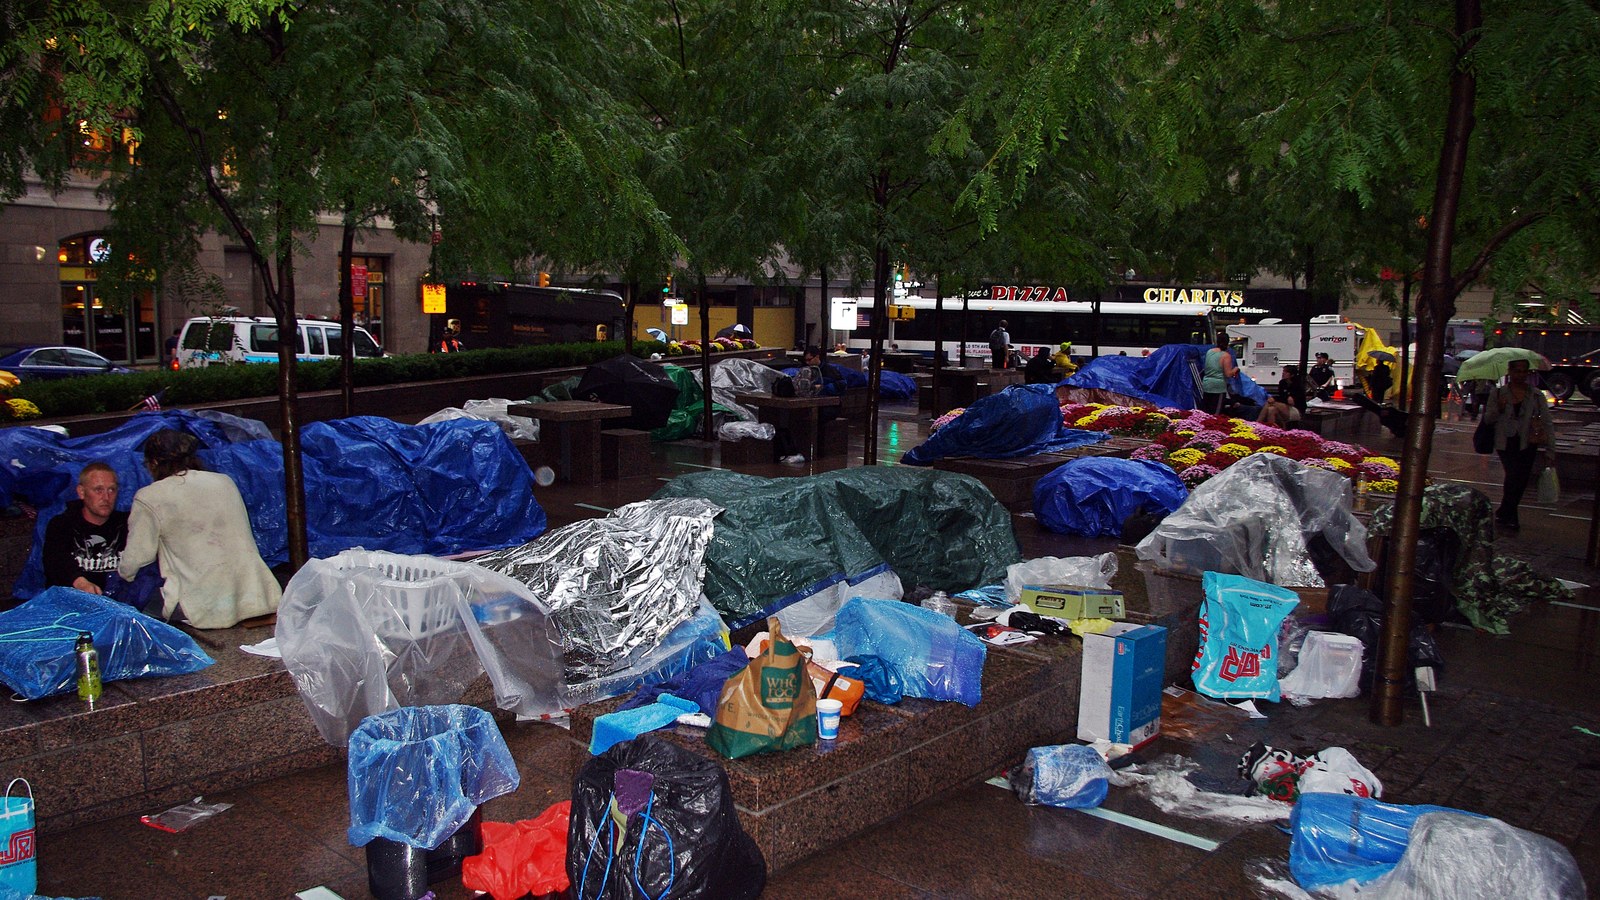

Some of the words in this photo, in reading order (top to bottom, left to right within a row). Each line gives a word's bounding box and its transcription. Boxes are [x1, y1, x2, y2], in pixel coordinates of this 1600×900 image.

[991, 285, 1068, 302] PIZZA
[1143, 287, 1245, 306] CHARLYS
[1319, 335, 1348, 344] verizon
